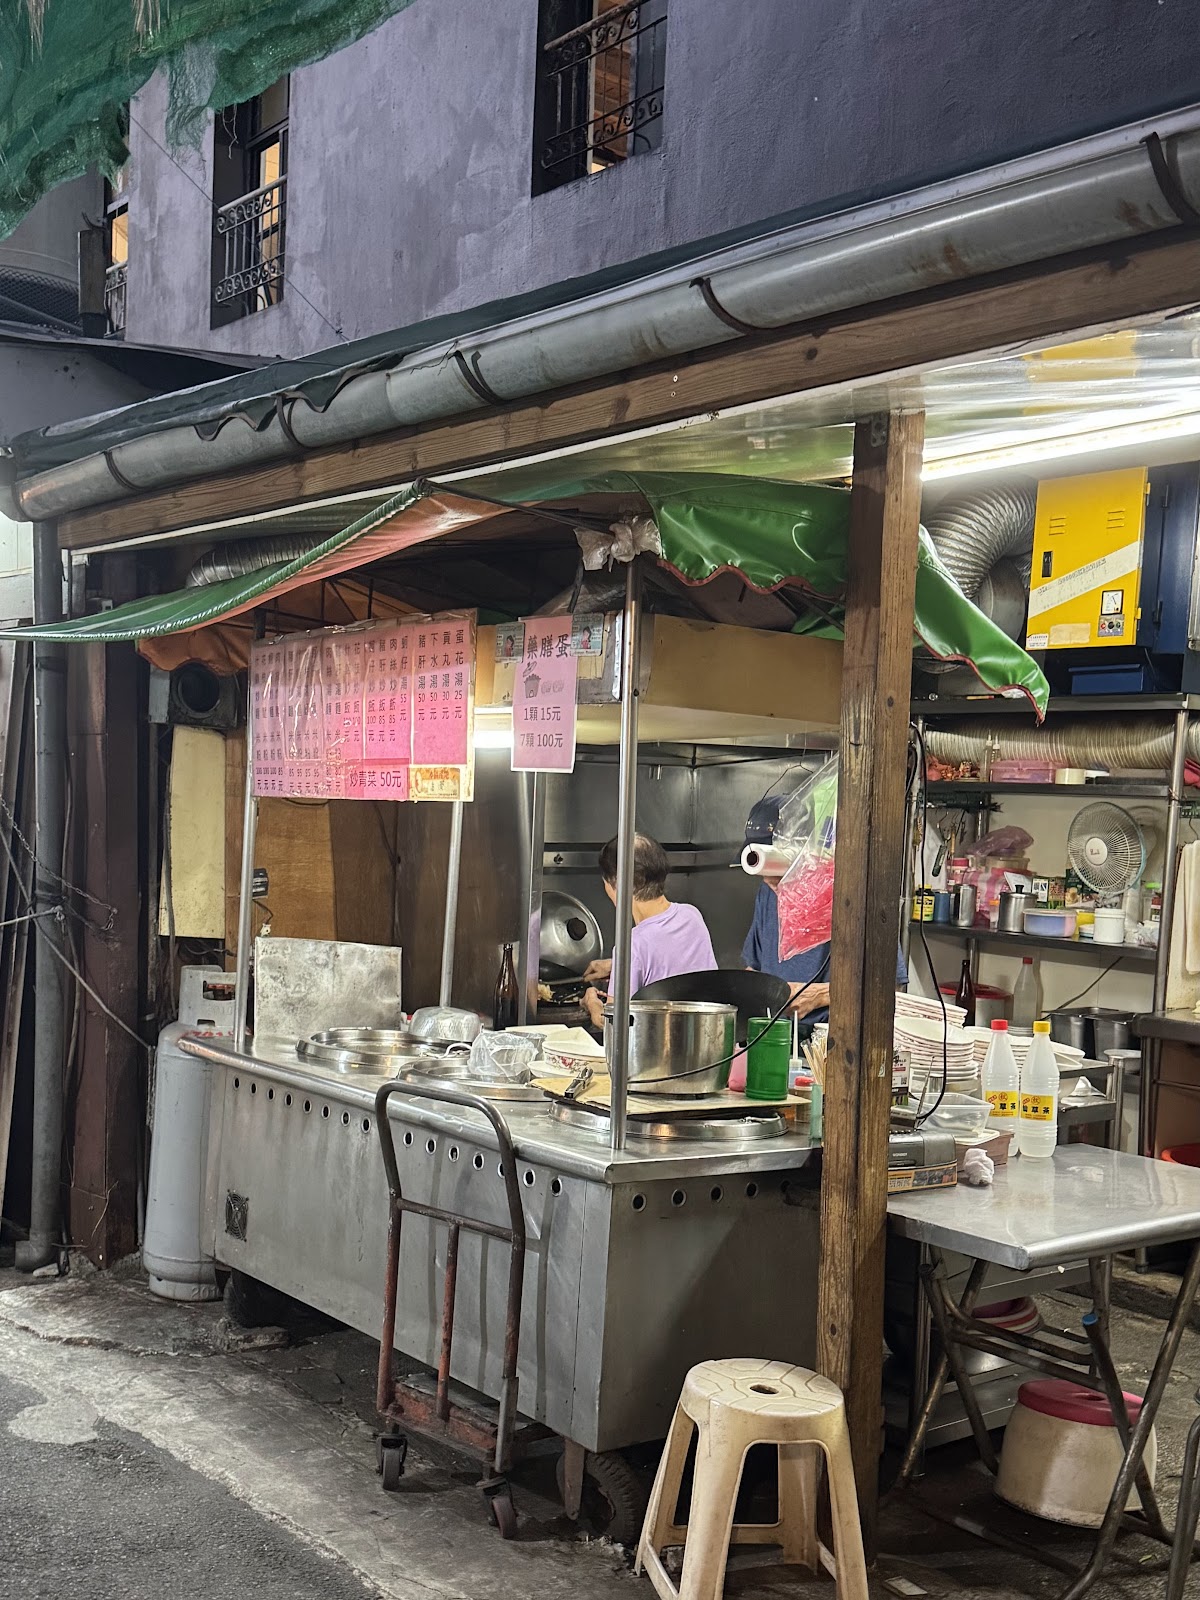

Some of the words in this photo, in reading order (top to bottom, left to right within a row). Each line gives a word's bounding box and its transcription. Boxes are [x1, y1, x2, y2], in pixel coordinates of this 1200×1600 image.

[389, 638, 398, 742] 肉絲炒飯85元
[418, 634, 426, 721] 豬肝湯50元
[430, 632, 438, 720] 下水湯50元
[442, 631, 451, 719] 貢丸湯30元
[455, 629, 464, 719] 蛋花湯25元
[527, 634, 571, 659] 藥膳蛋
[520, 733, 534, 748] 7顆
[537, 733, 564, 748] 100元
[524, 706, 538, 721] 1顆
[541, 706, 561, 721] 15元
[349, 770, 377, 788] 炒青菜
[380, 770, 402, 788] 50元
